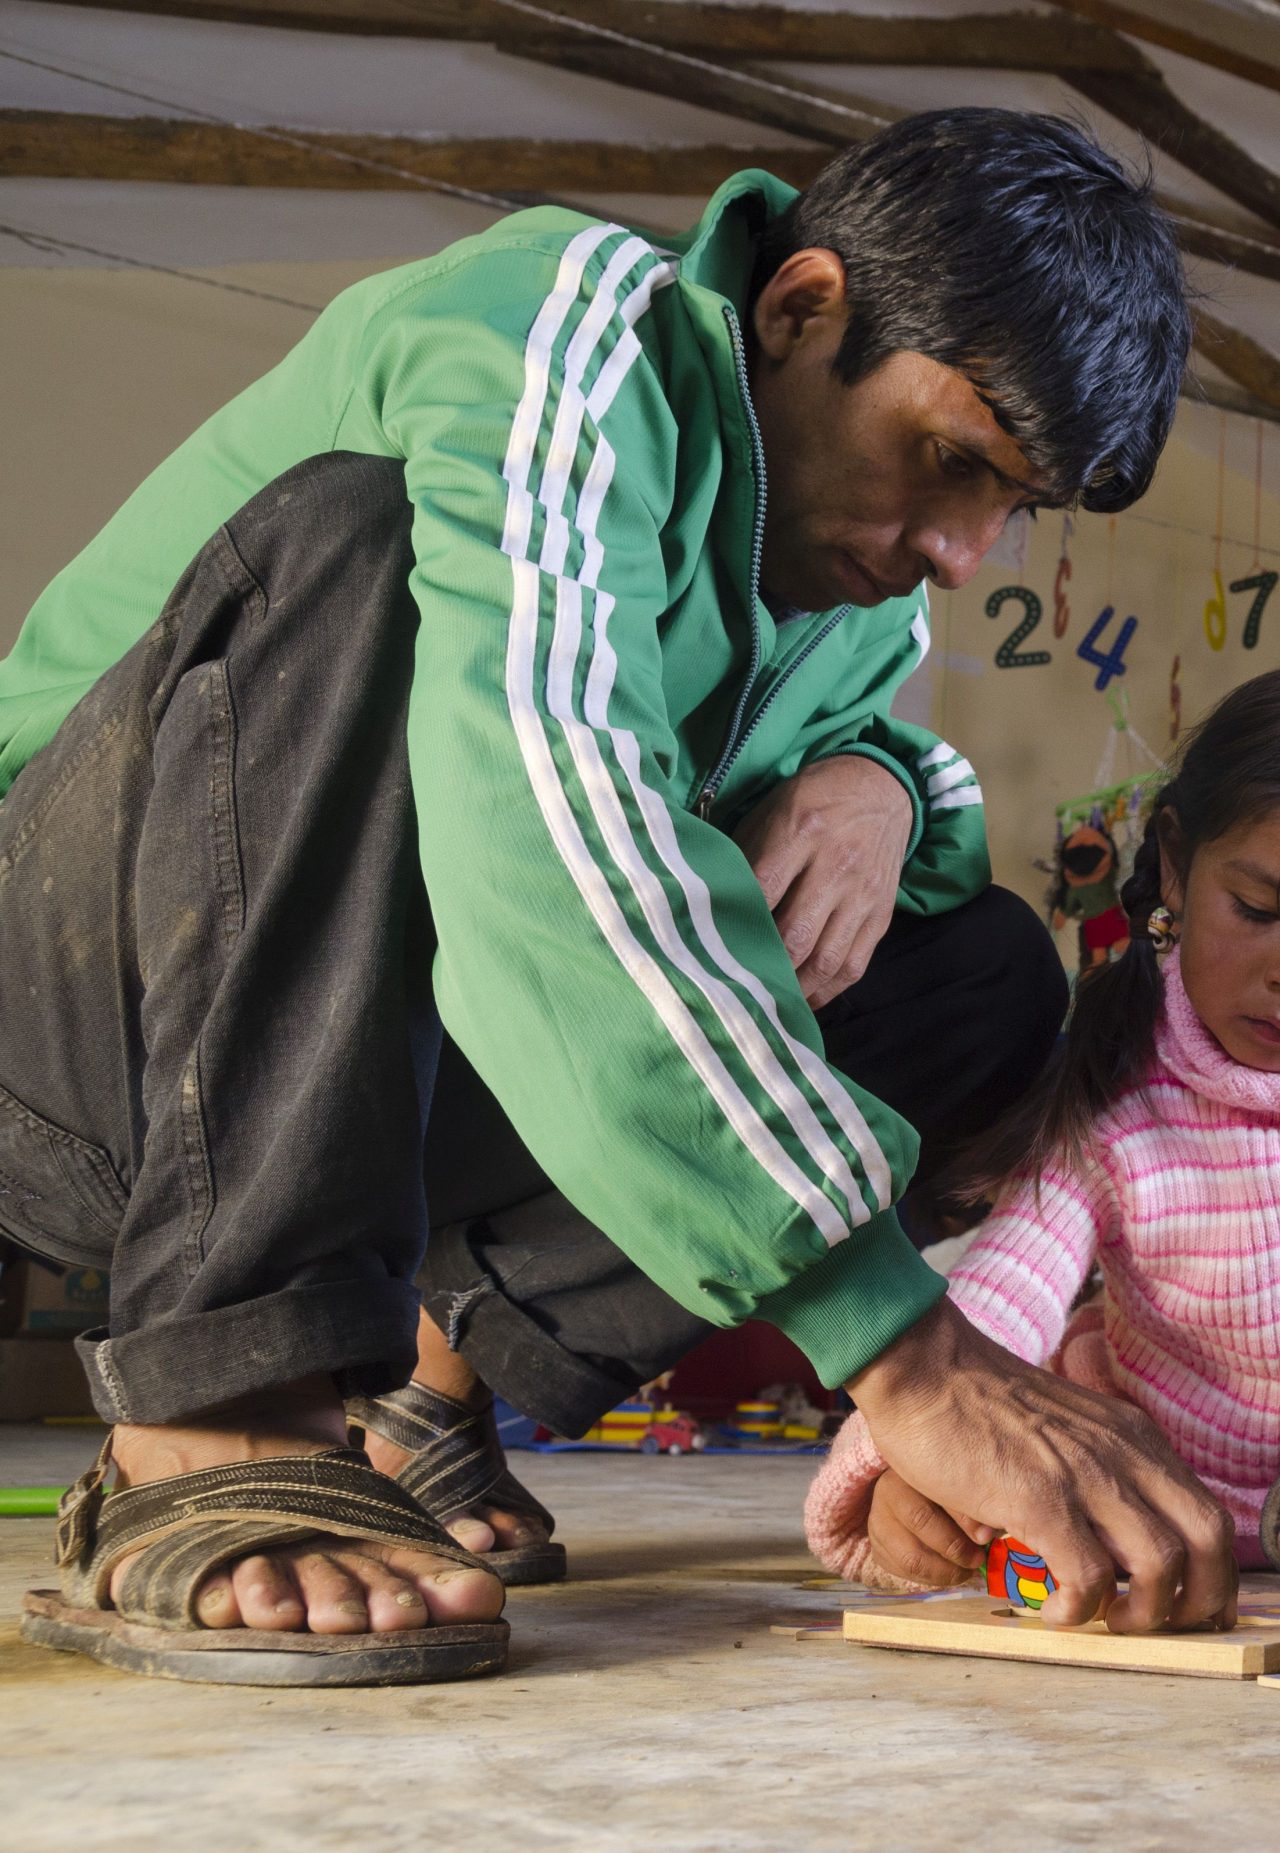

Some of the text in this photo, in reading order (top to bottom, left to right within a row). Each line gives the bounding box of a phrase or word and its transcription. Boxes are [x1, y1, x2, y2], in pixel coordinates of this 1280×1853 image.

[985, 585, 1052, 668] 2
[1076, 605, 1138, 691] 4
[1229, 571, 1279, 650] 7
